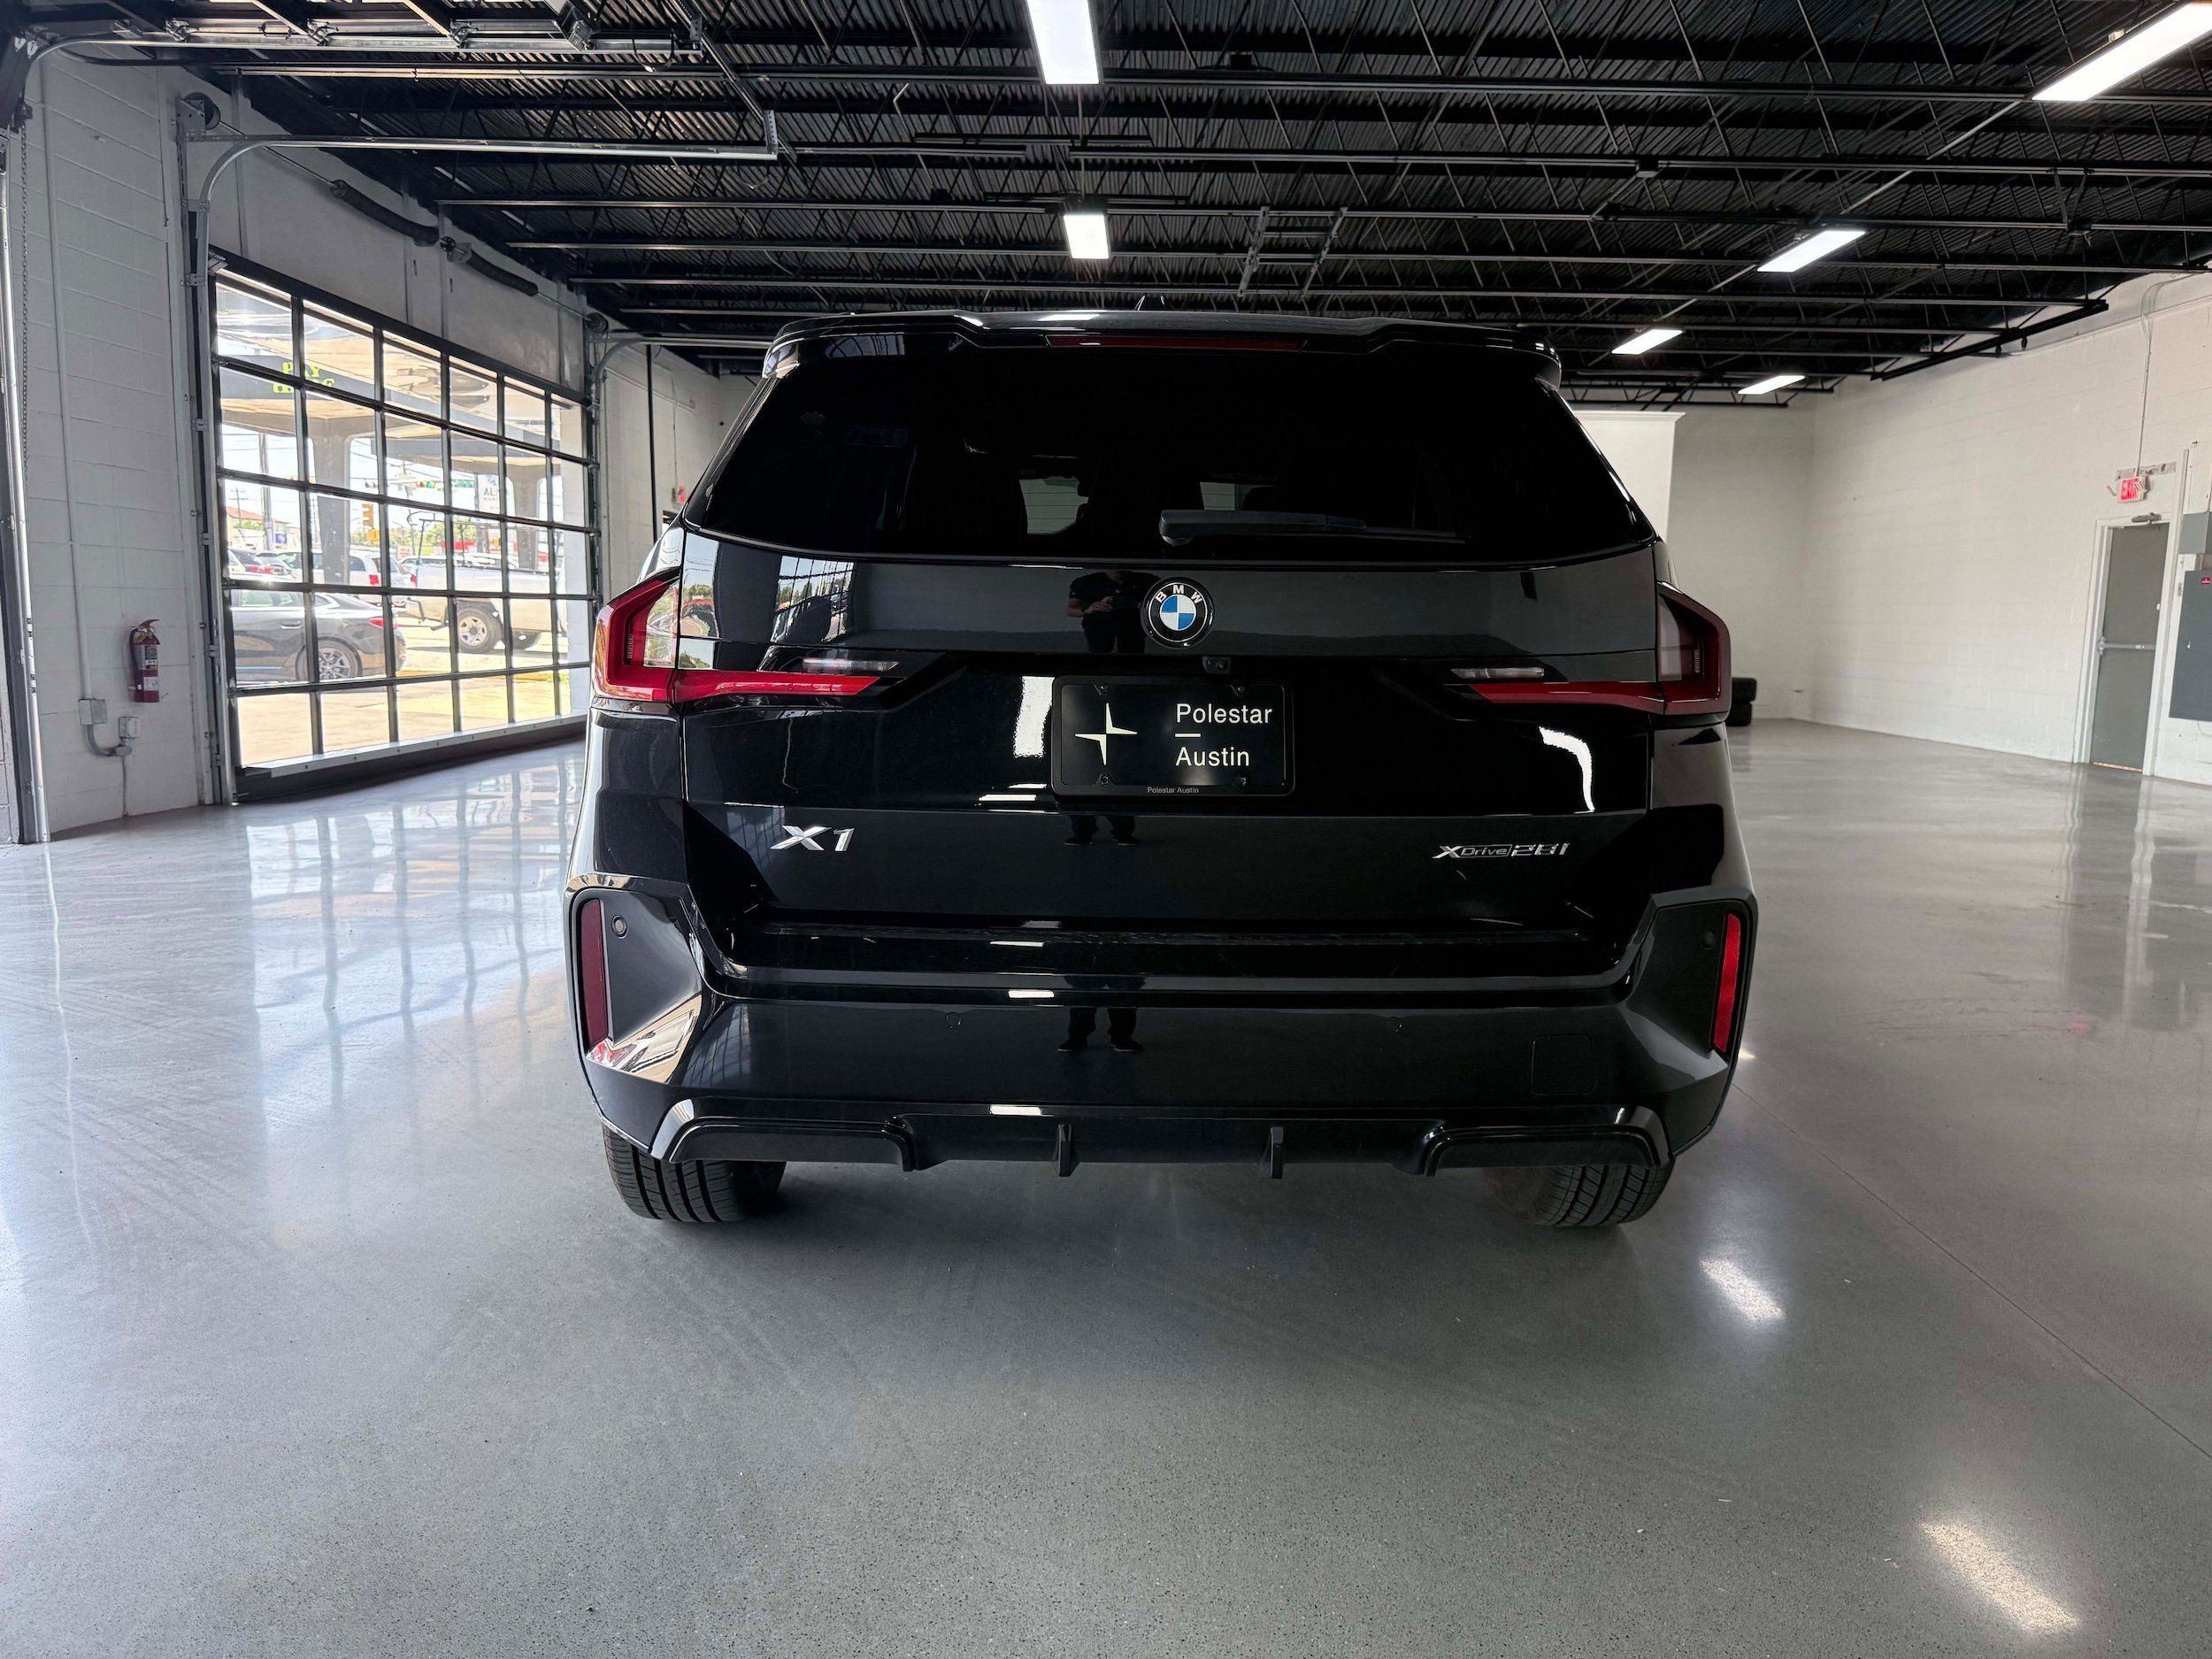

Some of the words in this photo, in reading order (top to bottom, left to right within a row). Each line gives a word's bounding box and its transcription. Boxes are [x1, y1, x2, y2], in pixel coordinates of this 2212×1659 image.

[1155, 584, 1203, 603] BMW
[1176, 703, 1272, 724] Polestar
[1175, 746, 1250, 767] Austin
[770, 825, 856, 852] X1
